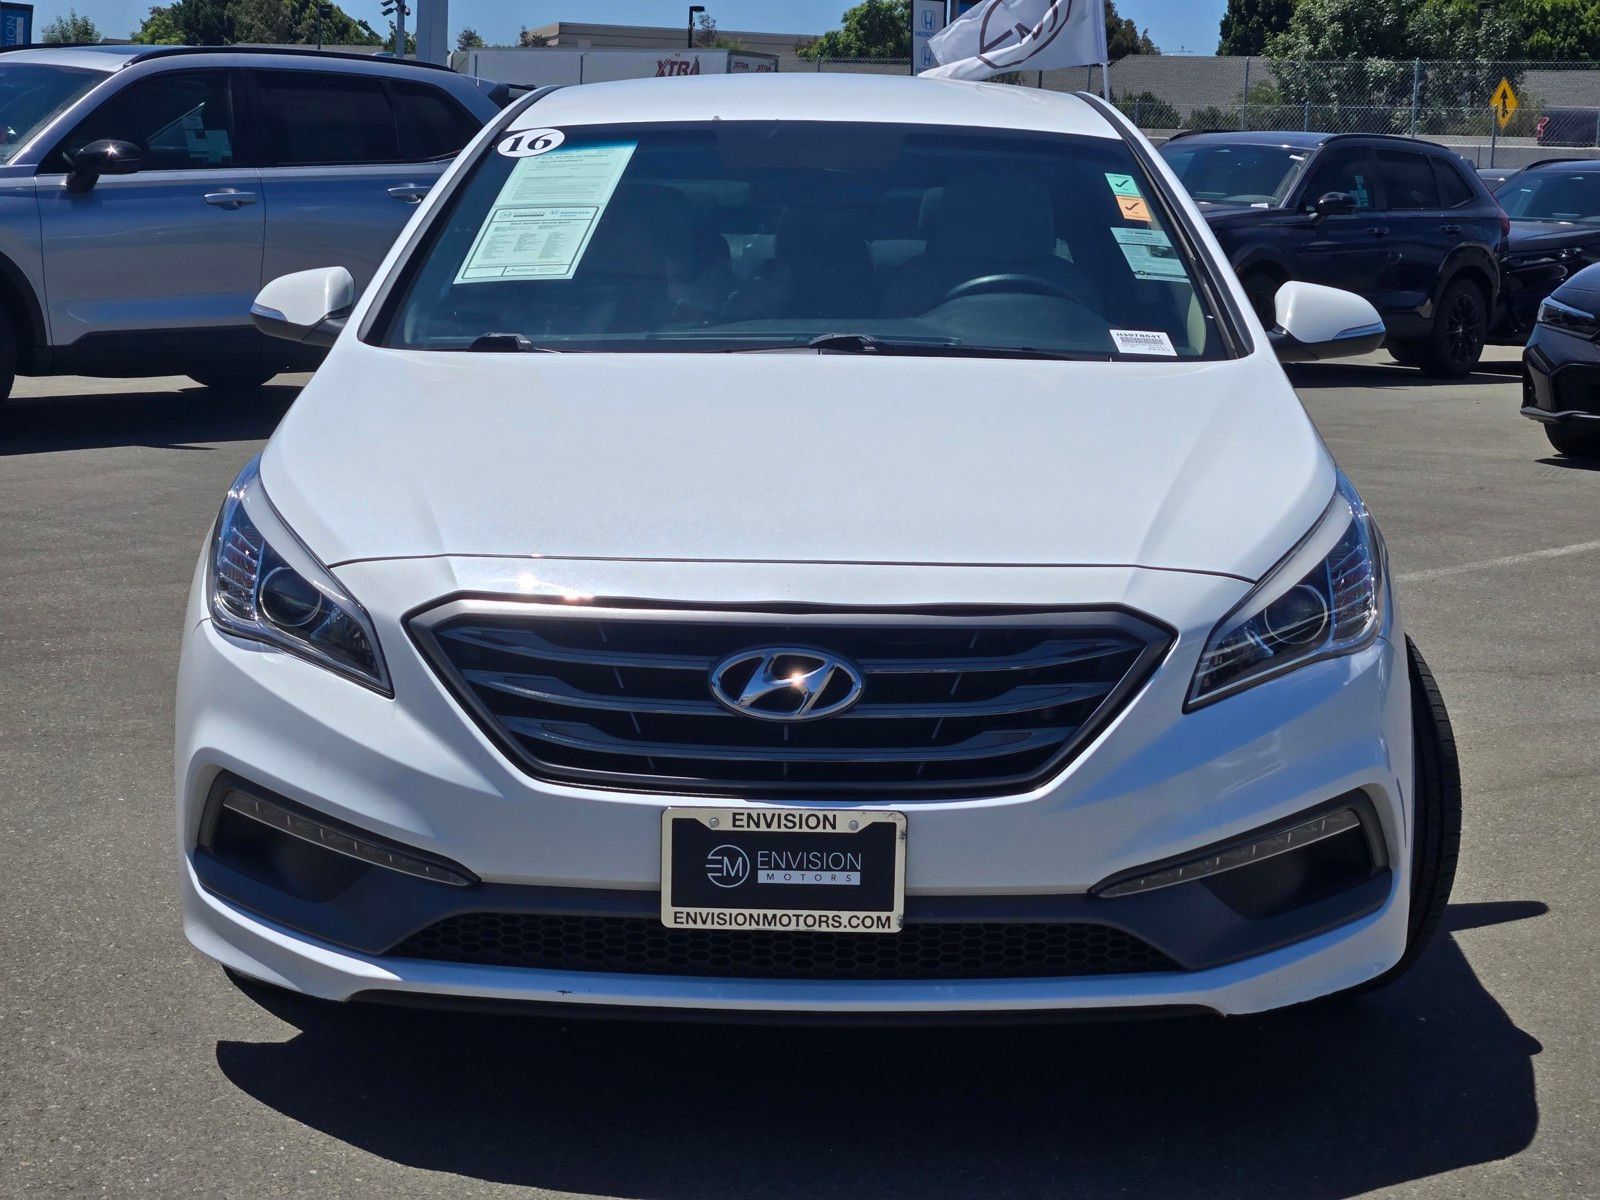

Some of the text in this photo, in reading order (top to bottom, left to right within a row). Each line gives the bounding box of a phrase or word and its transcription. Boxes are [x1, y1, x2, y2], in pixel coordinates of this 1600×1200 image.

[655, 59, 700, 77] XTRA
[502, 132, 557, 152] 16
[732, 812, 837, 830] ENVISION
[758, 851, 861, 870] ENVISION
[766, 873, 852, 882] MOTORS
[673, 911, 891, 929] ENVISIONMOTORS.COM
